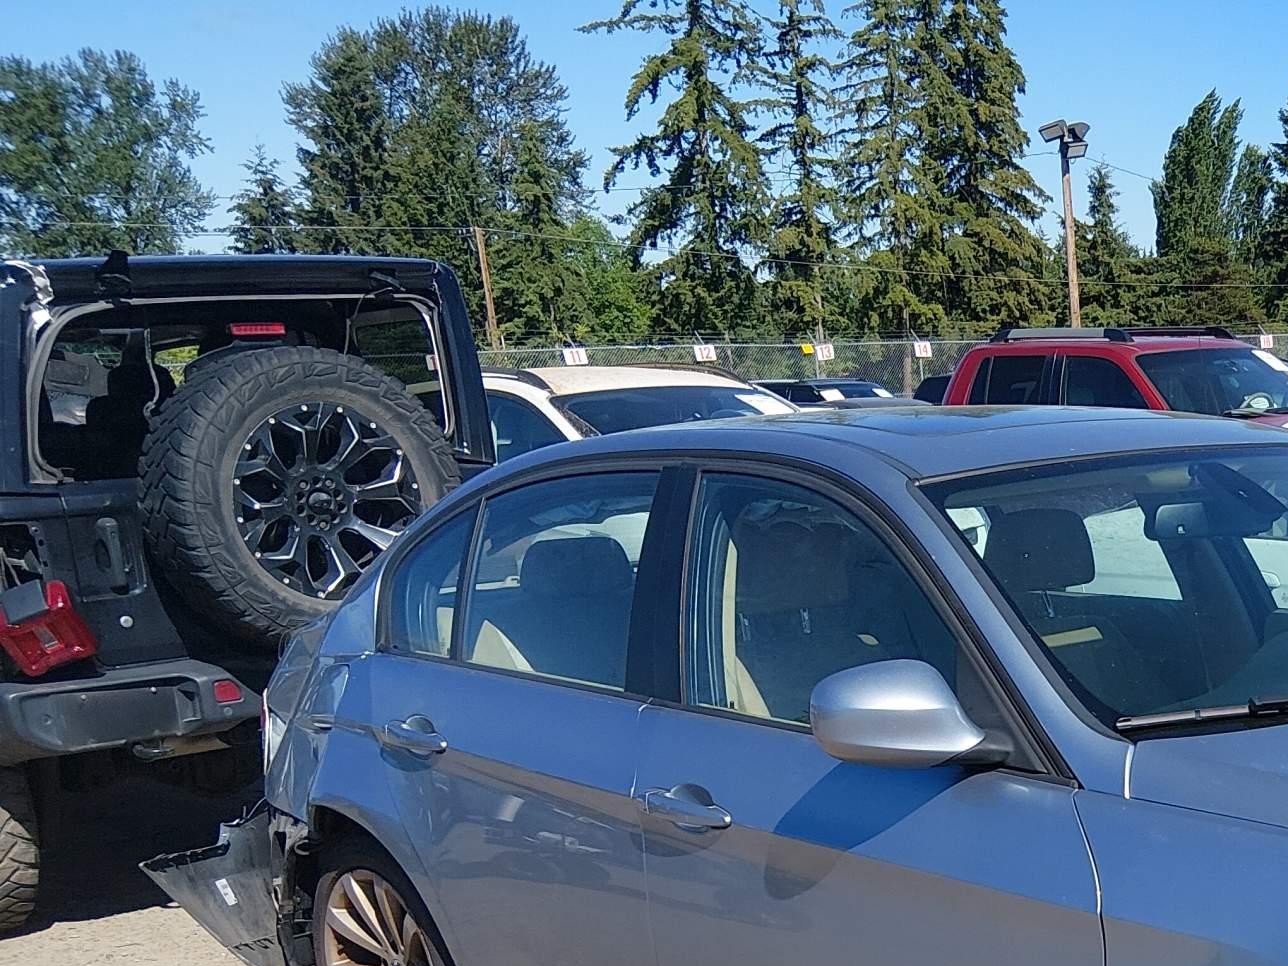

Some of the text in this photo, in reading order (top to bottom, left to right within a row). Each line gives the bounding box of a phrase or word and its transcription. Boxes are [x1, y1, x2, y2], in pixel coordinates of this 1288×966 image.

[570, 350, 581, 362] 11
[698, 347, 712, 359] 12
[820, 345, 832, 358] 13
